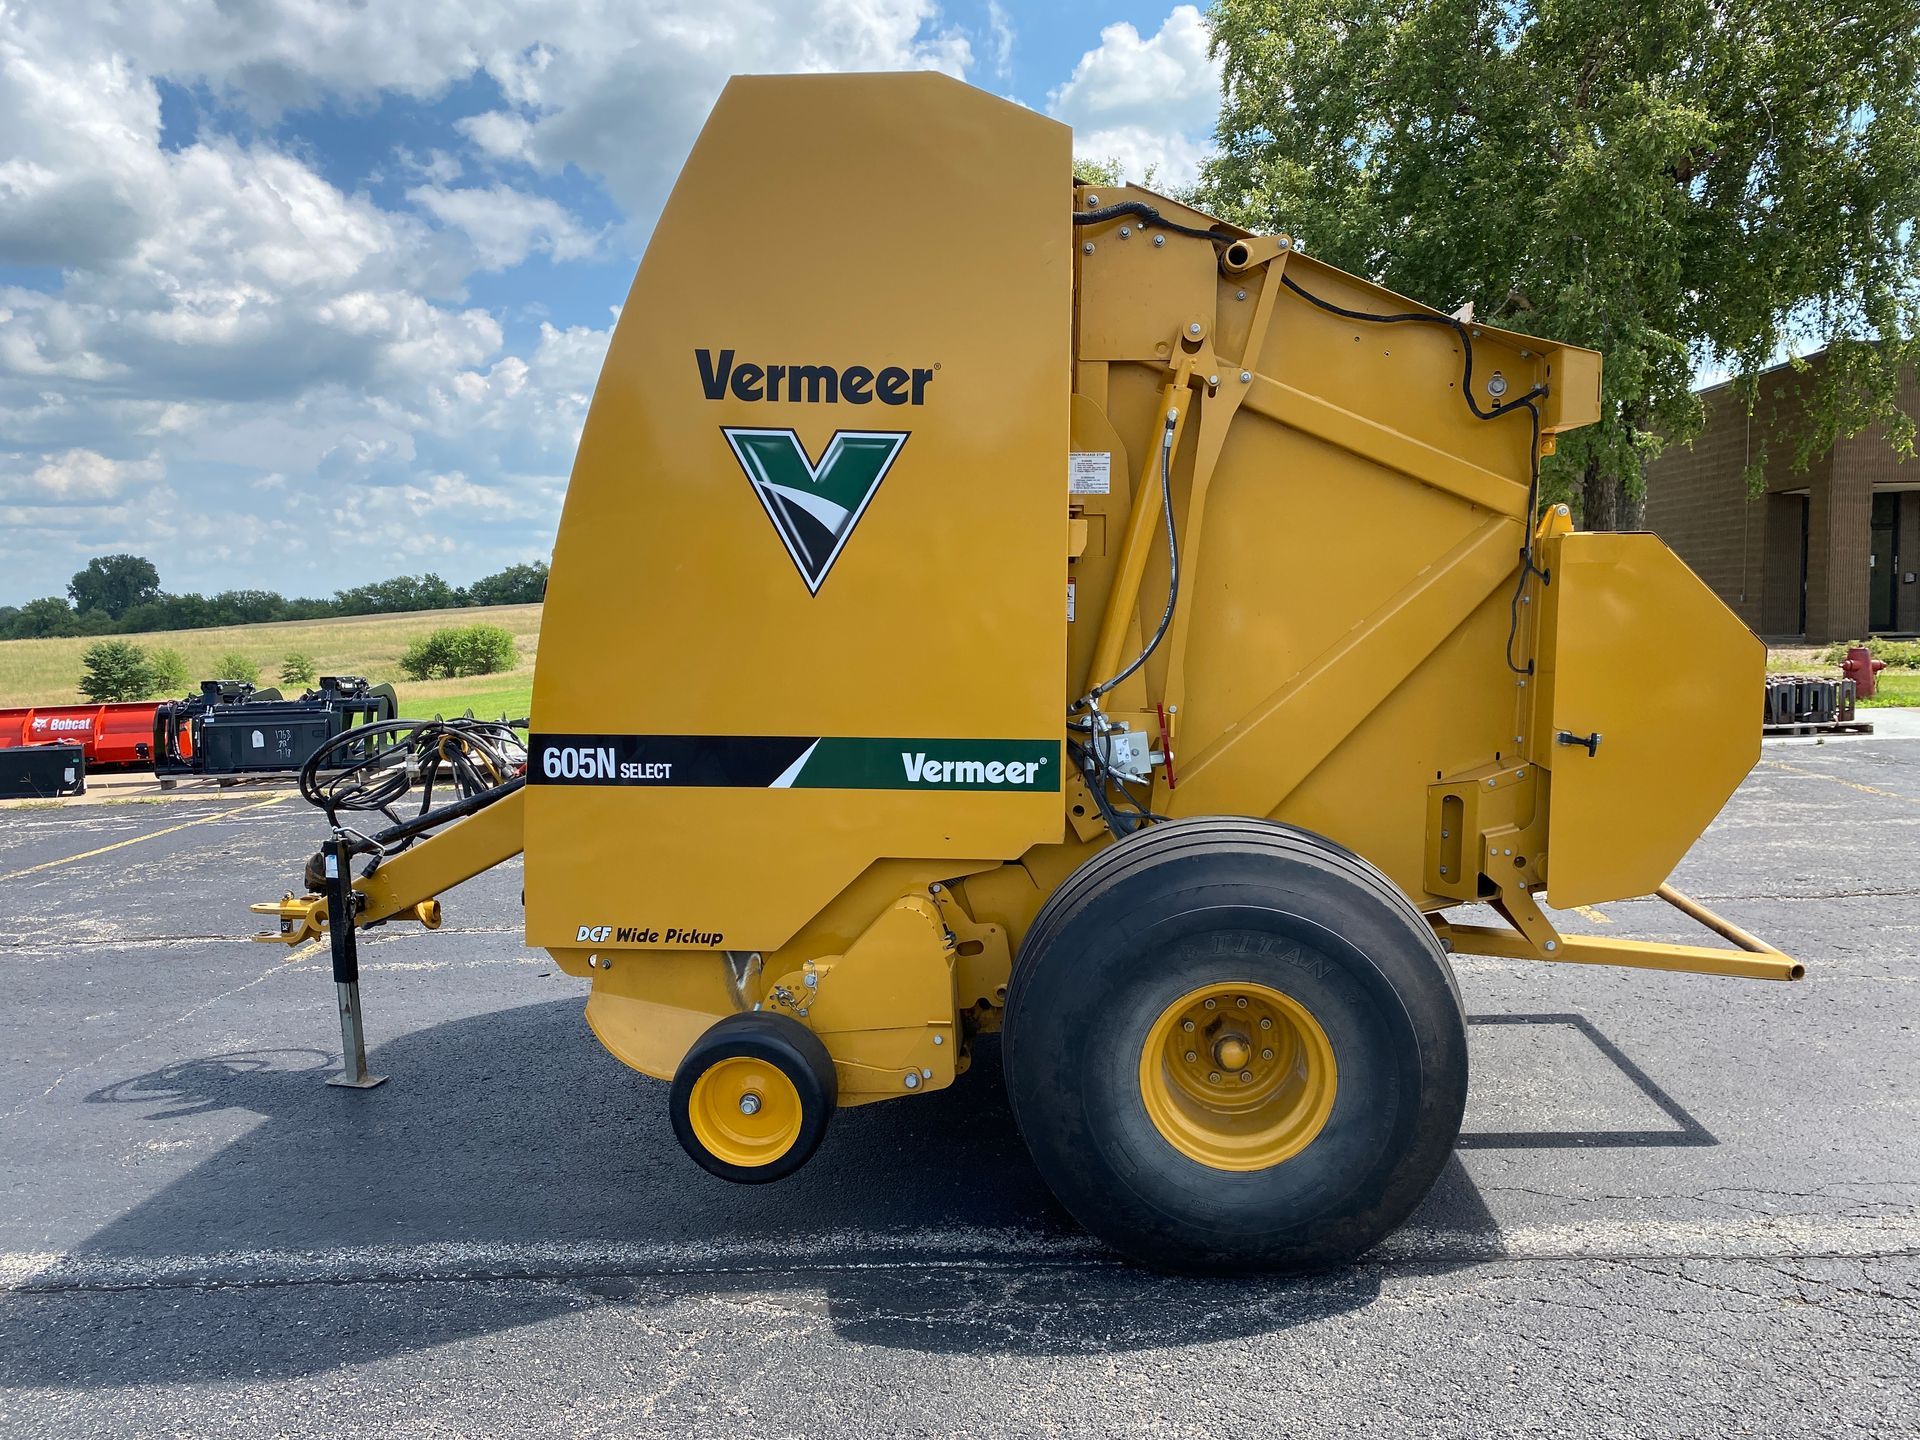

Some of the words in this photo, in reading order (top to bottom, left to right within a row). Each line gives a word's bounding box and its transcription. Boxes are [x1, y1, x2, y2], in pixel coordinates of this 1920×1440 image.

[50, 717, 91, 731] Bobcat
[543, 747, 616, 779] 605N
[620, 763, 672, 779] SELECT
[576, 925, 613, 943] DCF
[616, 927, 659, 943] Wide
[664, 928, 724, 947] Pickup
[1211, 934, 1337, 981] TITAN
